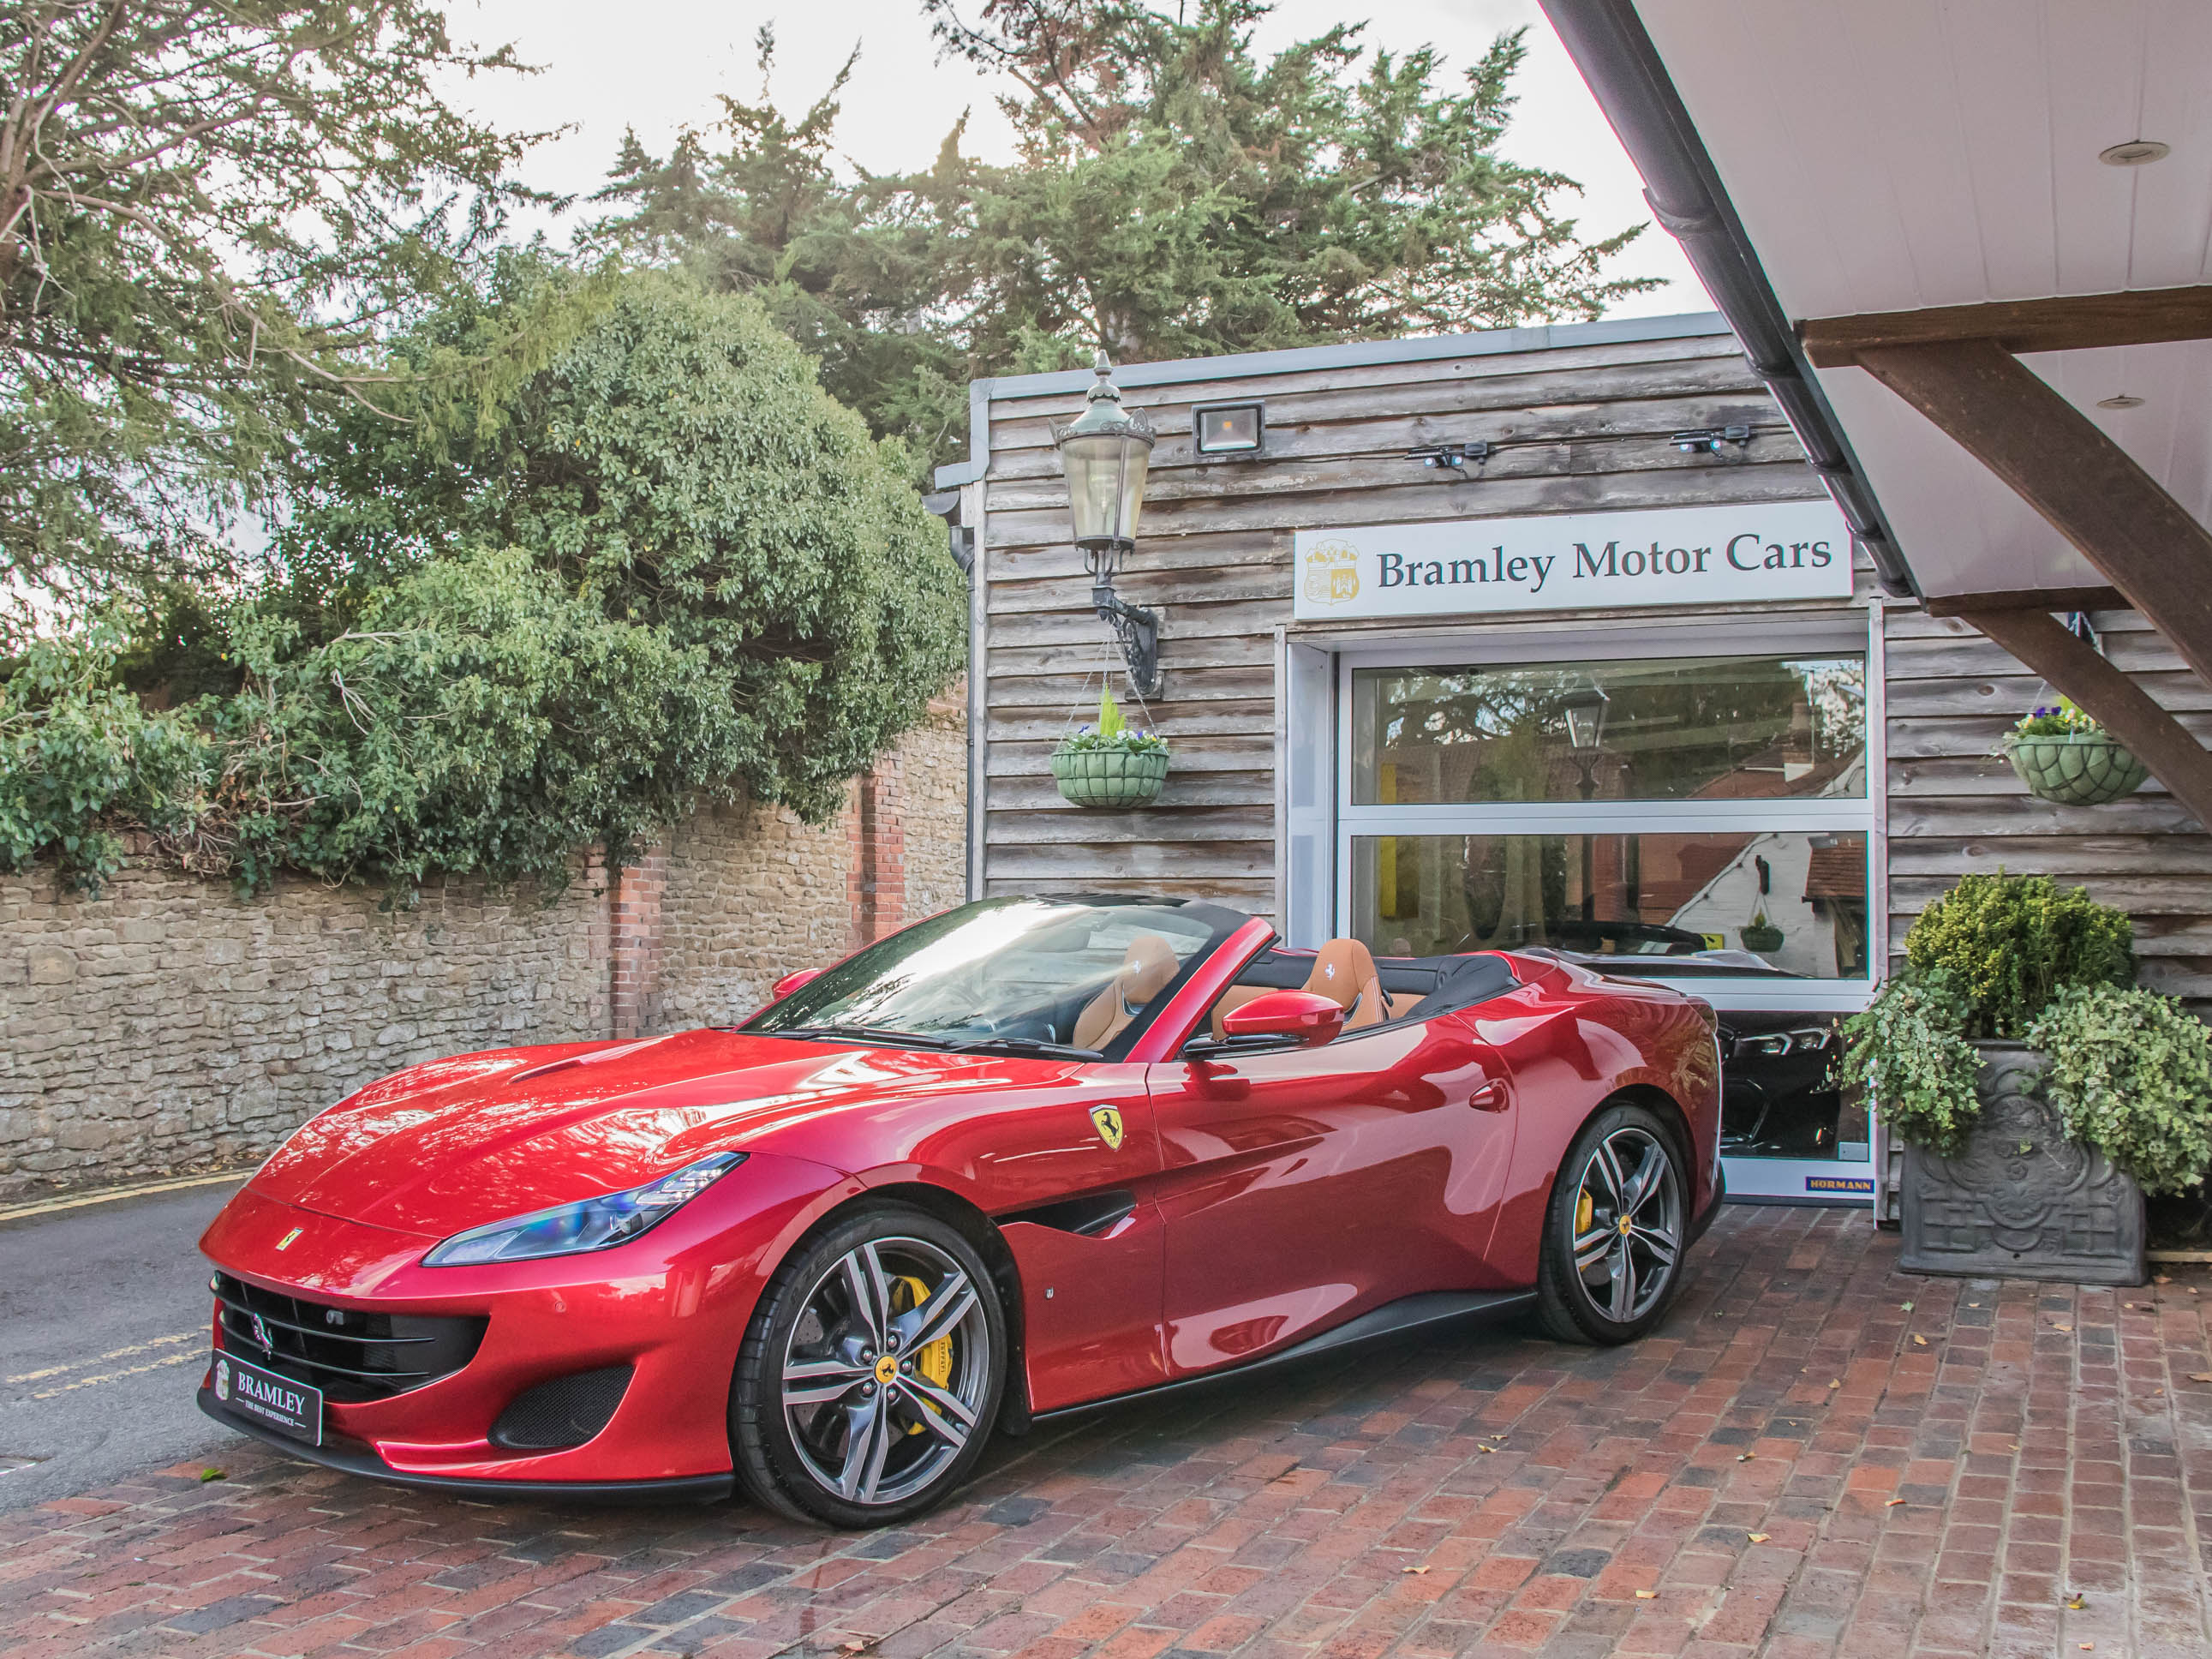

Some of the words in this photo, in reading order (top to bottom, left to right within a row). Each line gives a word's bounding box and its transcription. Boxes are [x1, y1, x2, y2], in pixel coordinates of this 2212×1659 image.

[1376, 545, 1557, 594] Bramley
[1572, 541, 1712, 578] Motor
[1726, 533, 1832, 572] Cars
[237, 1371, 306, 1416] BRAMLEY
[245, 1399, 254, 1411] THE
[254, 1404, 265, 1416] BEST
[265, 1408, 295, 1427] EXPERIENCE
